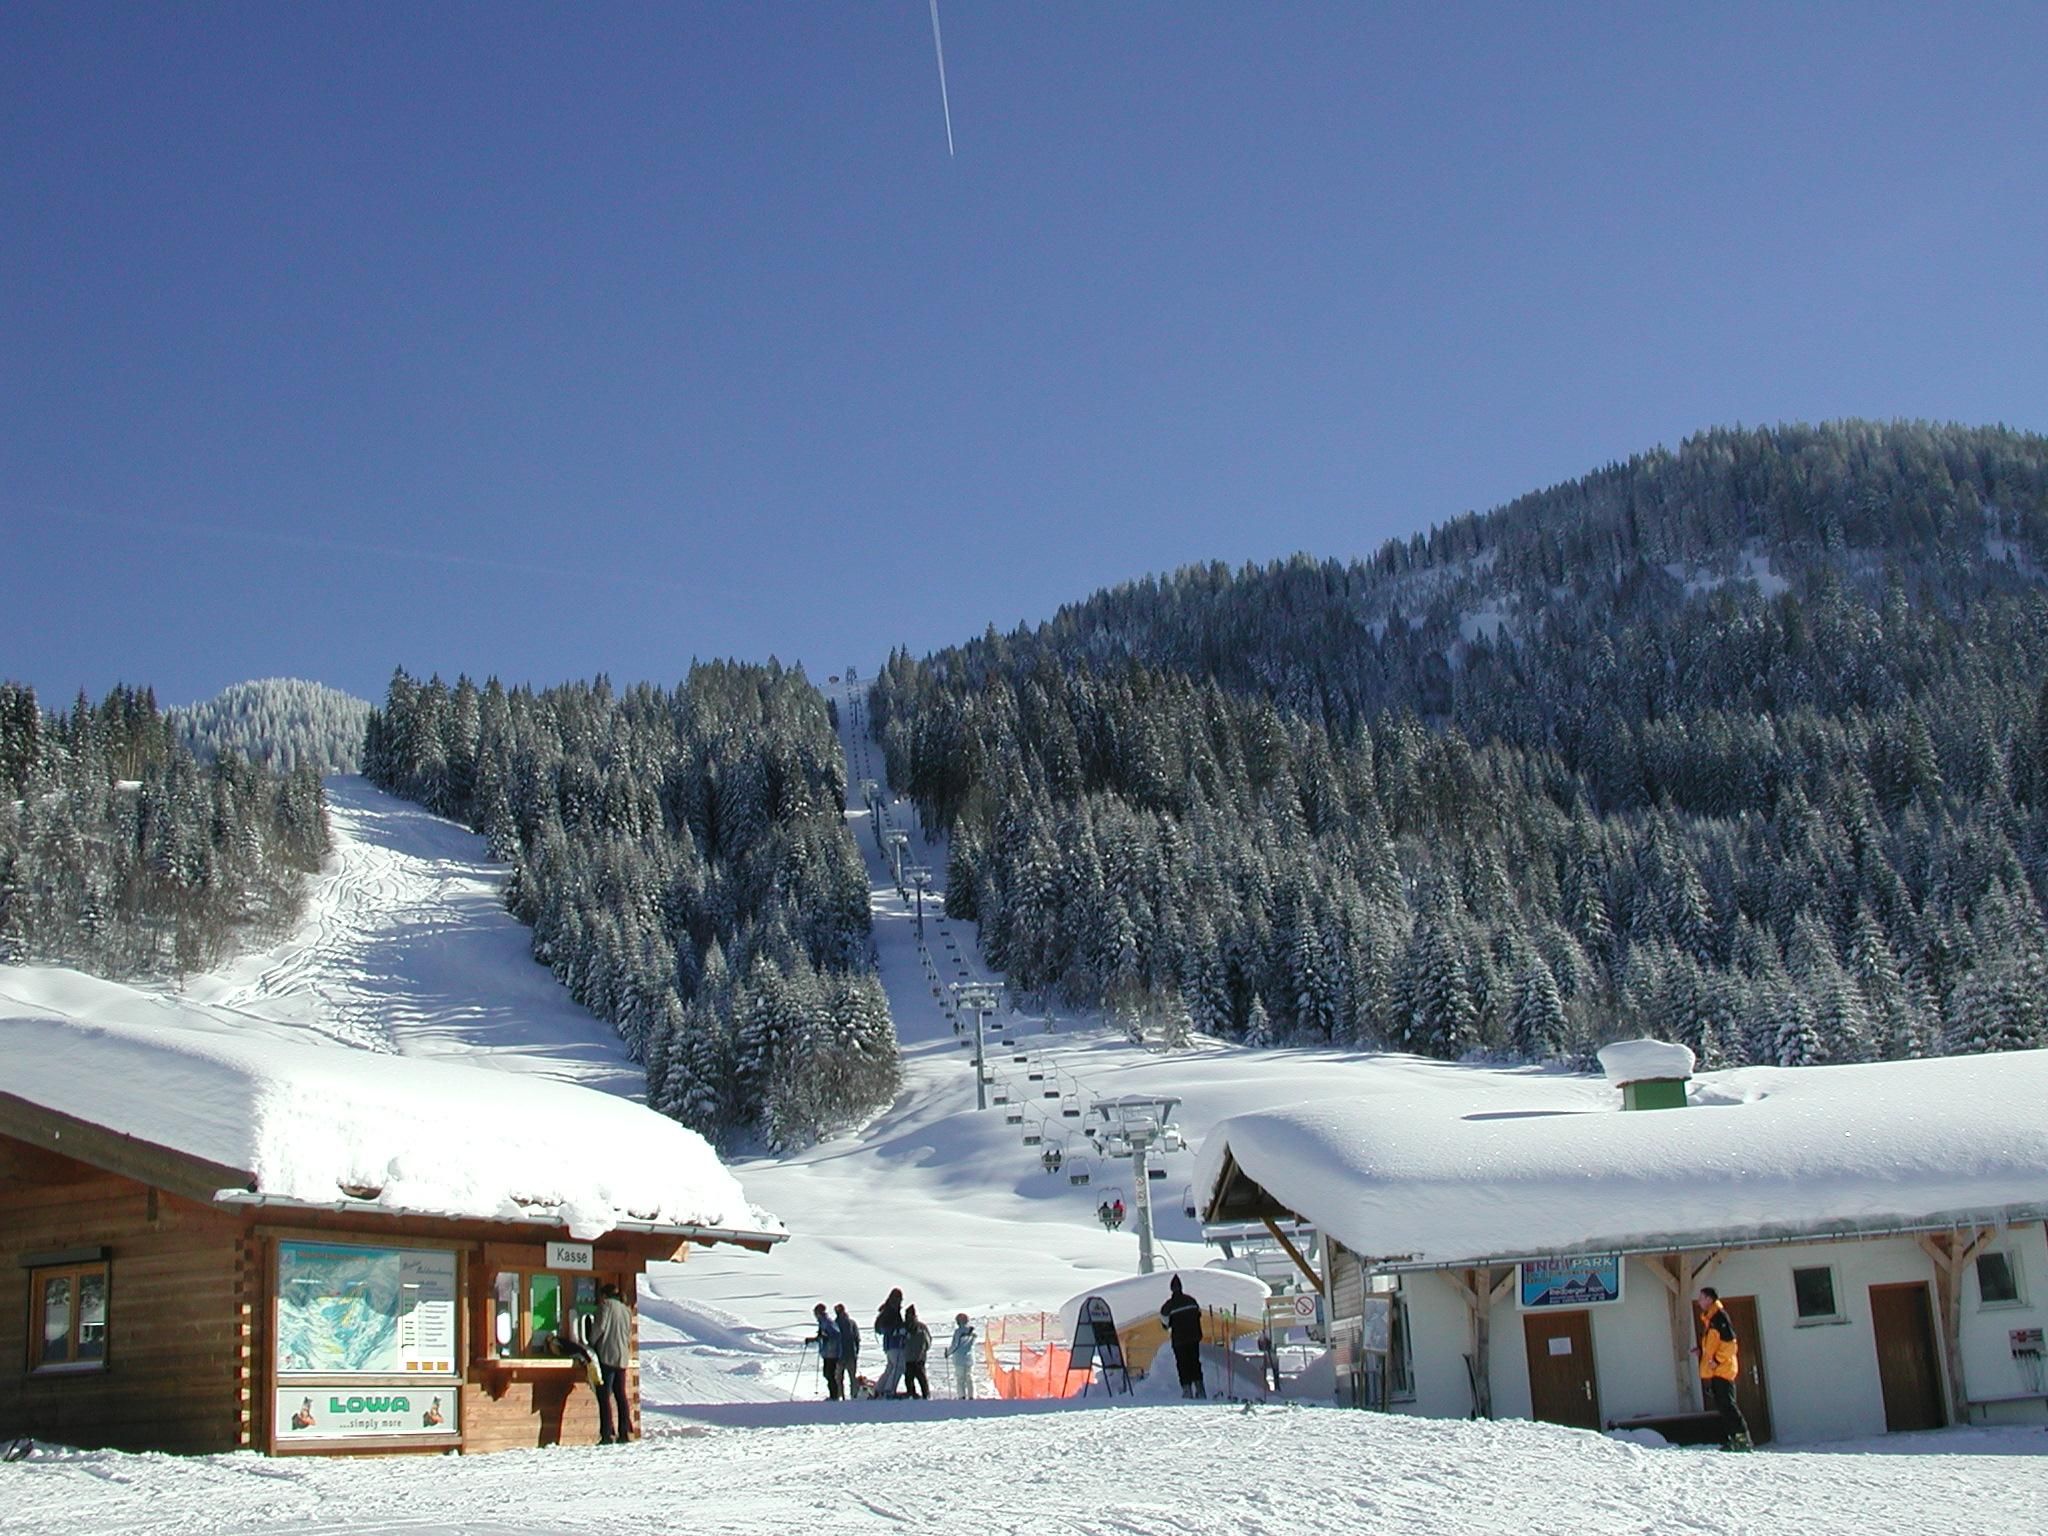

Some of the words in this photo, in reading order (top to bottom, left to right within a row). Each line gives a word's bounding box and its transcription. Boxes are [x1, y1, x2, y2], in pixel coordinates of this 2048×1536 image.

[557, 1247, 588, 1263] Kasse
[1572, 1256, 1613, 1268] PARK
[330, 1397, 410, 1413] LOWA
[382, 1419, 402, 1427] more
